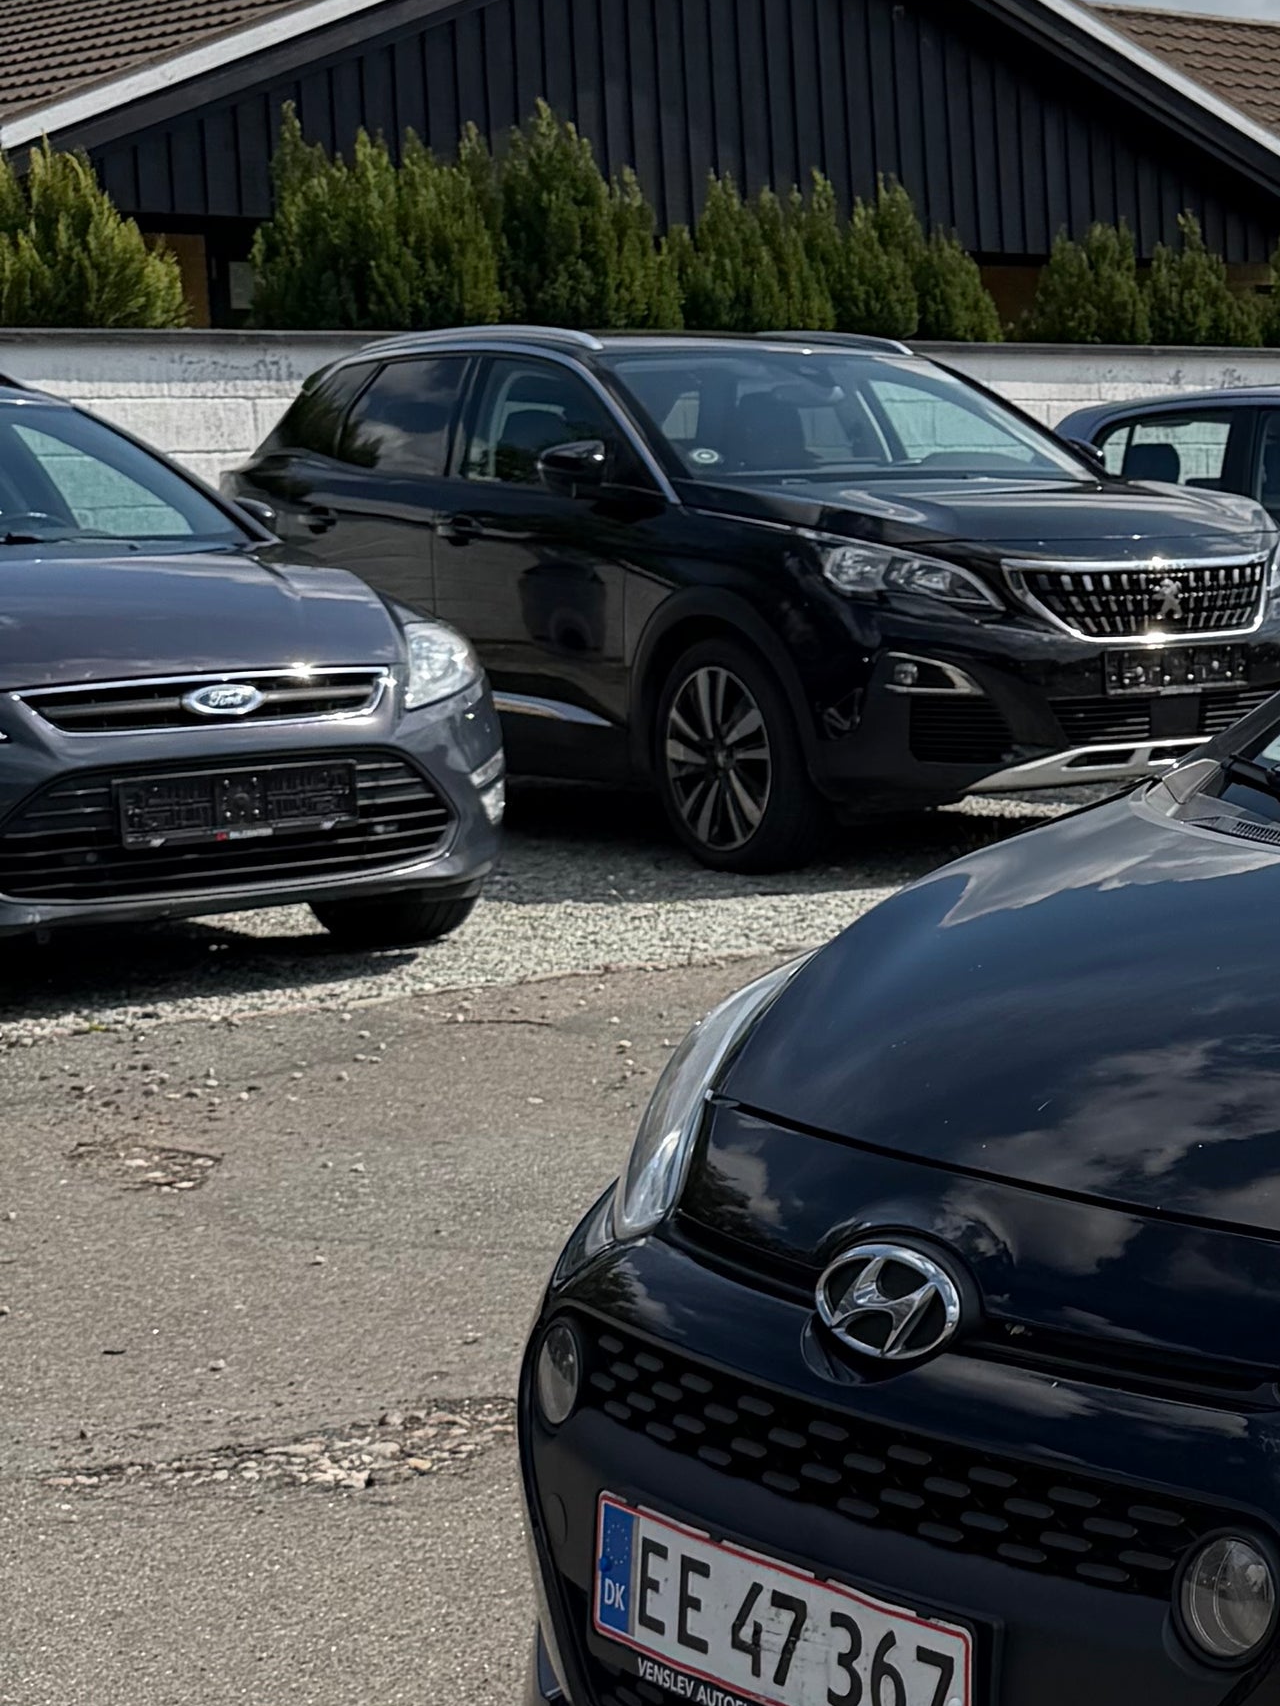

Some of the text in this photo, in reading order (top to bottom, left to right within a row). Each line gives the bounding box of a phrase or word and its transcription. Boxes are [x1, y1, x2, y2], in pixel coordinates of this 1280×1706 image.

[603, 1582, 626, 1612] DK
[638, 1537, 711, 1655] EE
[731, 1581, 808, 1687] 47
[637, 1656, 696, 1698] VENSLEV
